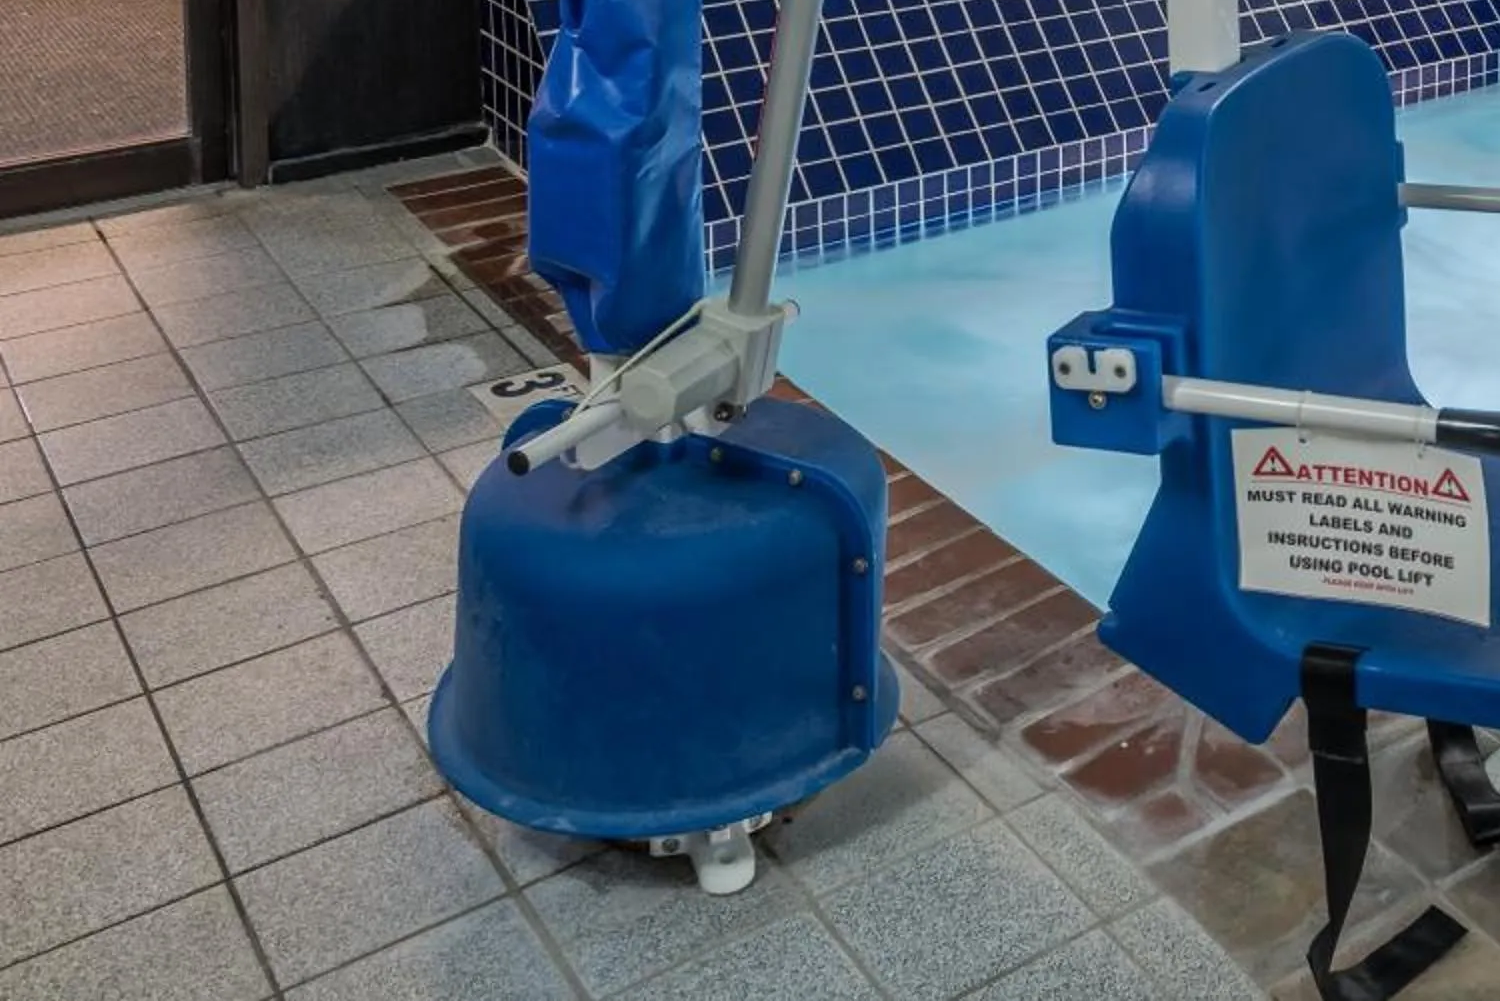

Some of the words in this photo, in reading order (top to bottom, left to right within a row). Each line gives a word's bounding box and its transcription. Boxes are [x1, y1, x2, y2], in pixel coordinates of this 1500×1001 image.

[491, 372, 566, 397] 3
[1296, 464, 1429, 496] ATTENTION
[1247, 490, 1297, 504] MUST
[1302, 492, 1347, 508] READ
[1352, 498, 1384, 514] ALL
[1387, 502, 1467, 528] WARNING
[1309, 513, 1373, 534] LABELS
[1378, 523, 1413, 540] AND
[1267, 531, 1384, 556] INSRUCTIONS
[1389, 546, 1455, 570] BEFORE
[1289, 555, 1343, 574] USING
[1348, 561, 1394, 580] POOL
[1398, 566, 1435, 587] LIFT
